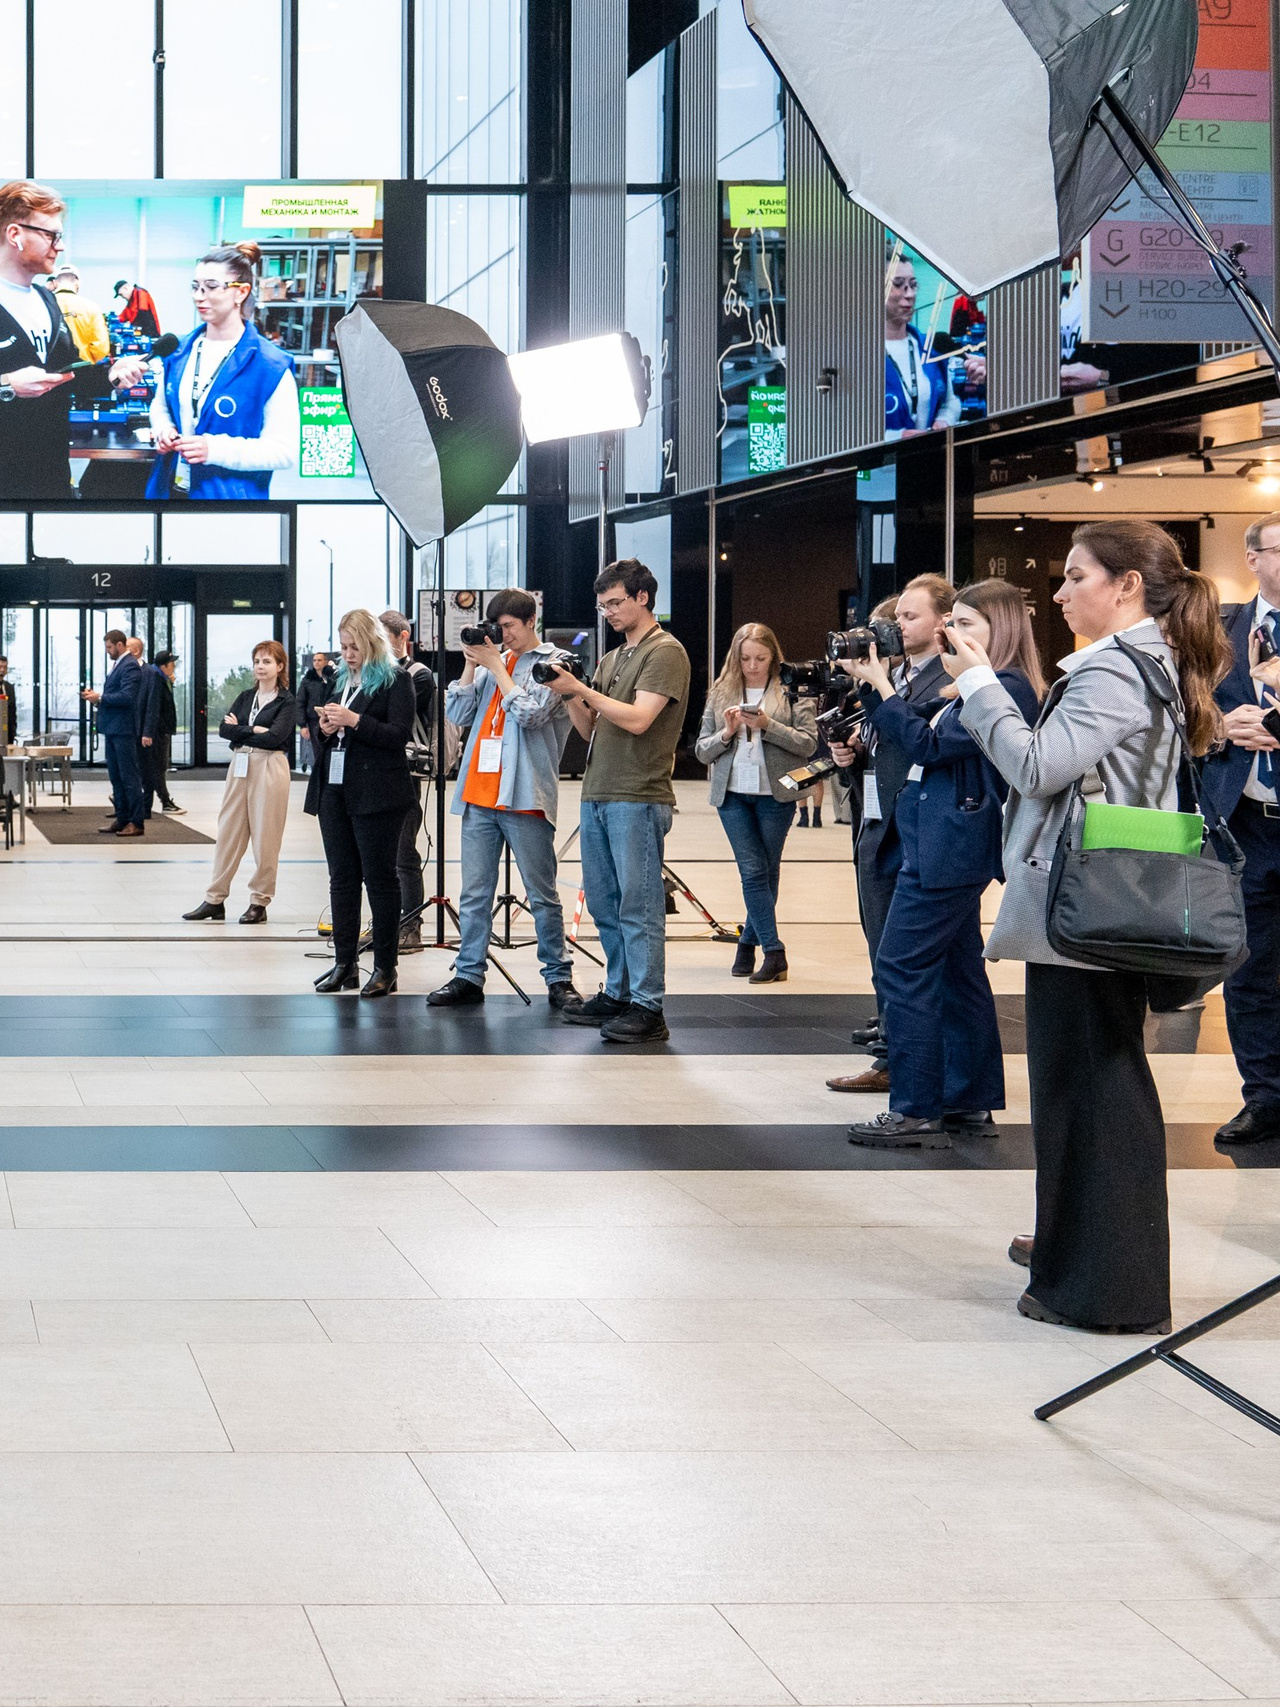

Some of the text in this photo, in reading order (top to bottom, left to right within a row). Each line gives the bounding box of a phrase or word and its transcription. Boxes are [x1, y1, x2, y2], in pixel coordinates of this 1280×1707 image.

[271, 198, 349, 207] ПРОМЫШЛЕННАЯ
[260, 208, 359, 216] МЕХАНИКА И МОНТАЖ
[1107, 229, 1123, 251] G
[1105, 280, 1123, 302] H
[1139, 279, 1227, 298] H20-29
[1139, 308, 1177, 320] H100
[303, 391, 343, 404] Прямо
[429, 376, 450, 419] Godox
[303, 404, 336, 417] эфир
[91, 573, 112, 587] 12
